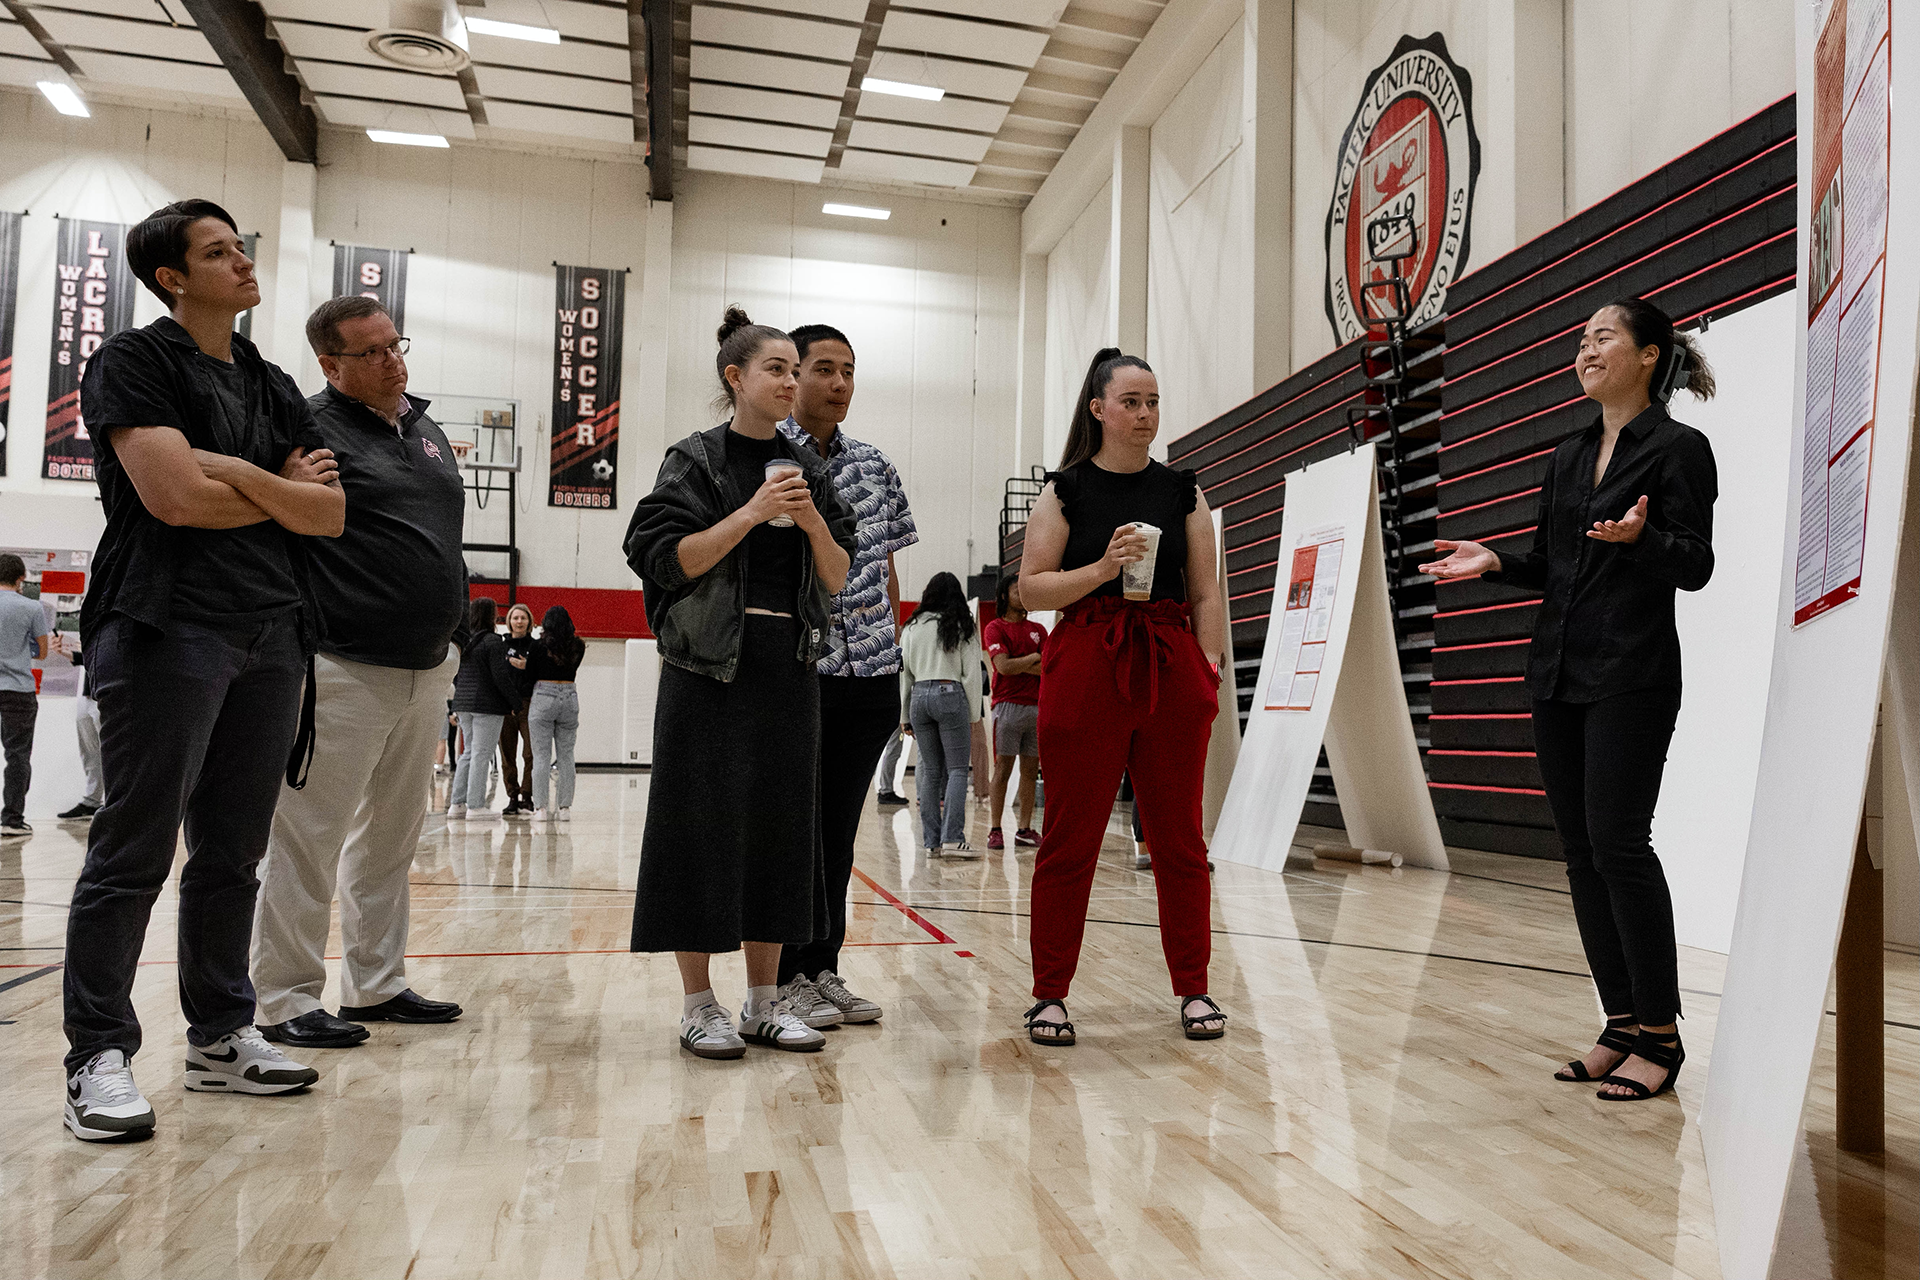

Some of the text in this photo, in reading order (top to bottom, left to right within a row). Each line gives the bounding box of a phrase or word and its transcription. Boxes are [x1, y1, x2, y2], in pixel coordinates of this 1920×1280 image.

[1334, 55, 1462, 227] PACIFIC UNIVERSITY
[57, 264, 83, 366] WOMEN'S
[74, 230, 109, 440] LACRO
[558, 308, 578, 402] WOMEN'S
[576, 277, 601, 446] SOCCER
[48, 462, 96, 480] BOXE
[554, 491, 611, 508] BOXERS
